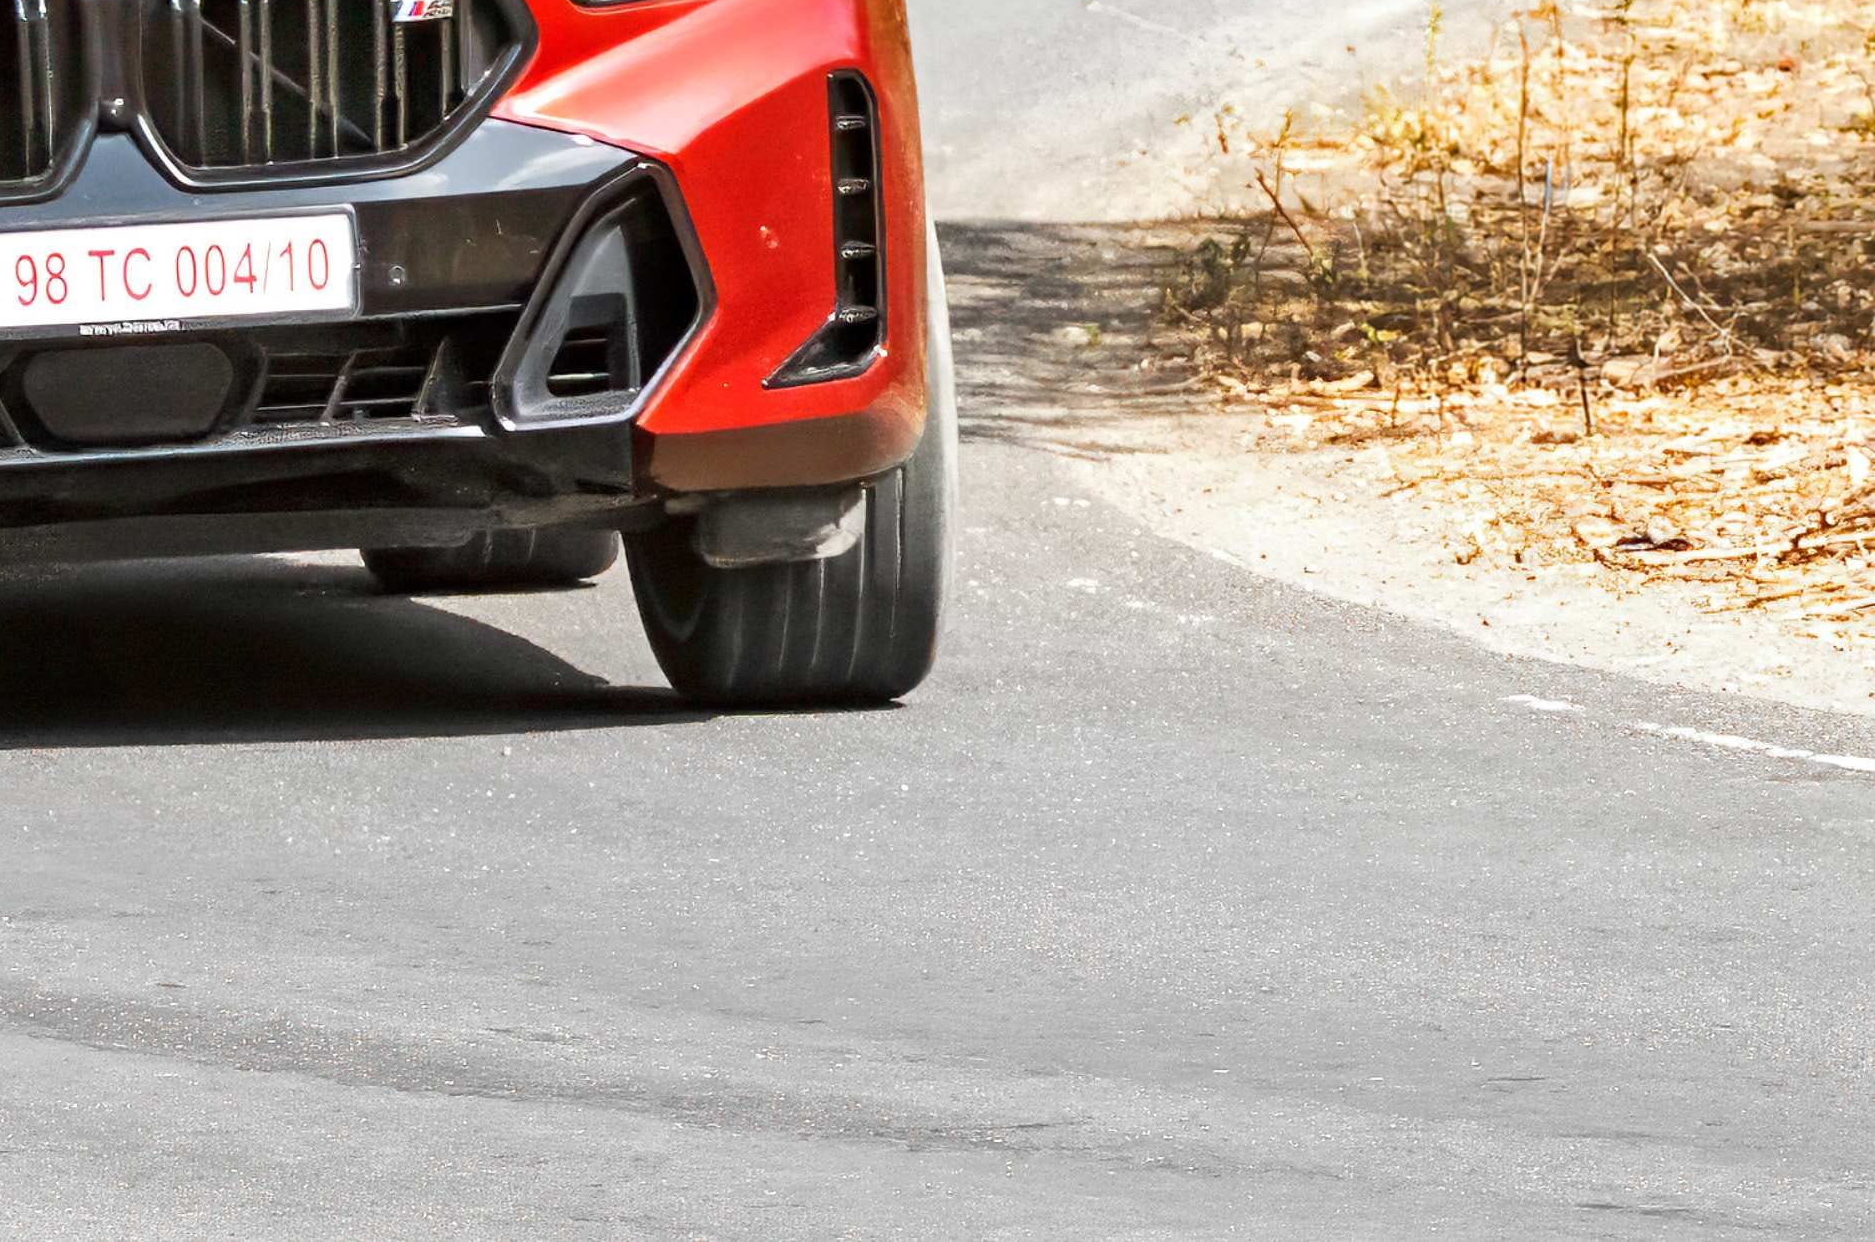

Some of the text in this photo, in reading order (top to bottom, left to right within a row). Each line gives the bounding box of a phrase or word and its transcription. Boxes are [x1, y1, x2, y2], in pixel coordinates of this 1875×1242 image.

[15, 251, 68, 306] 98
[88, 246, 153, 301] TC
[175, 238, 329, 297] 004/10
